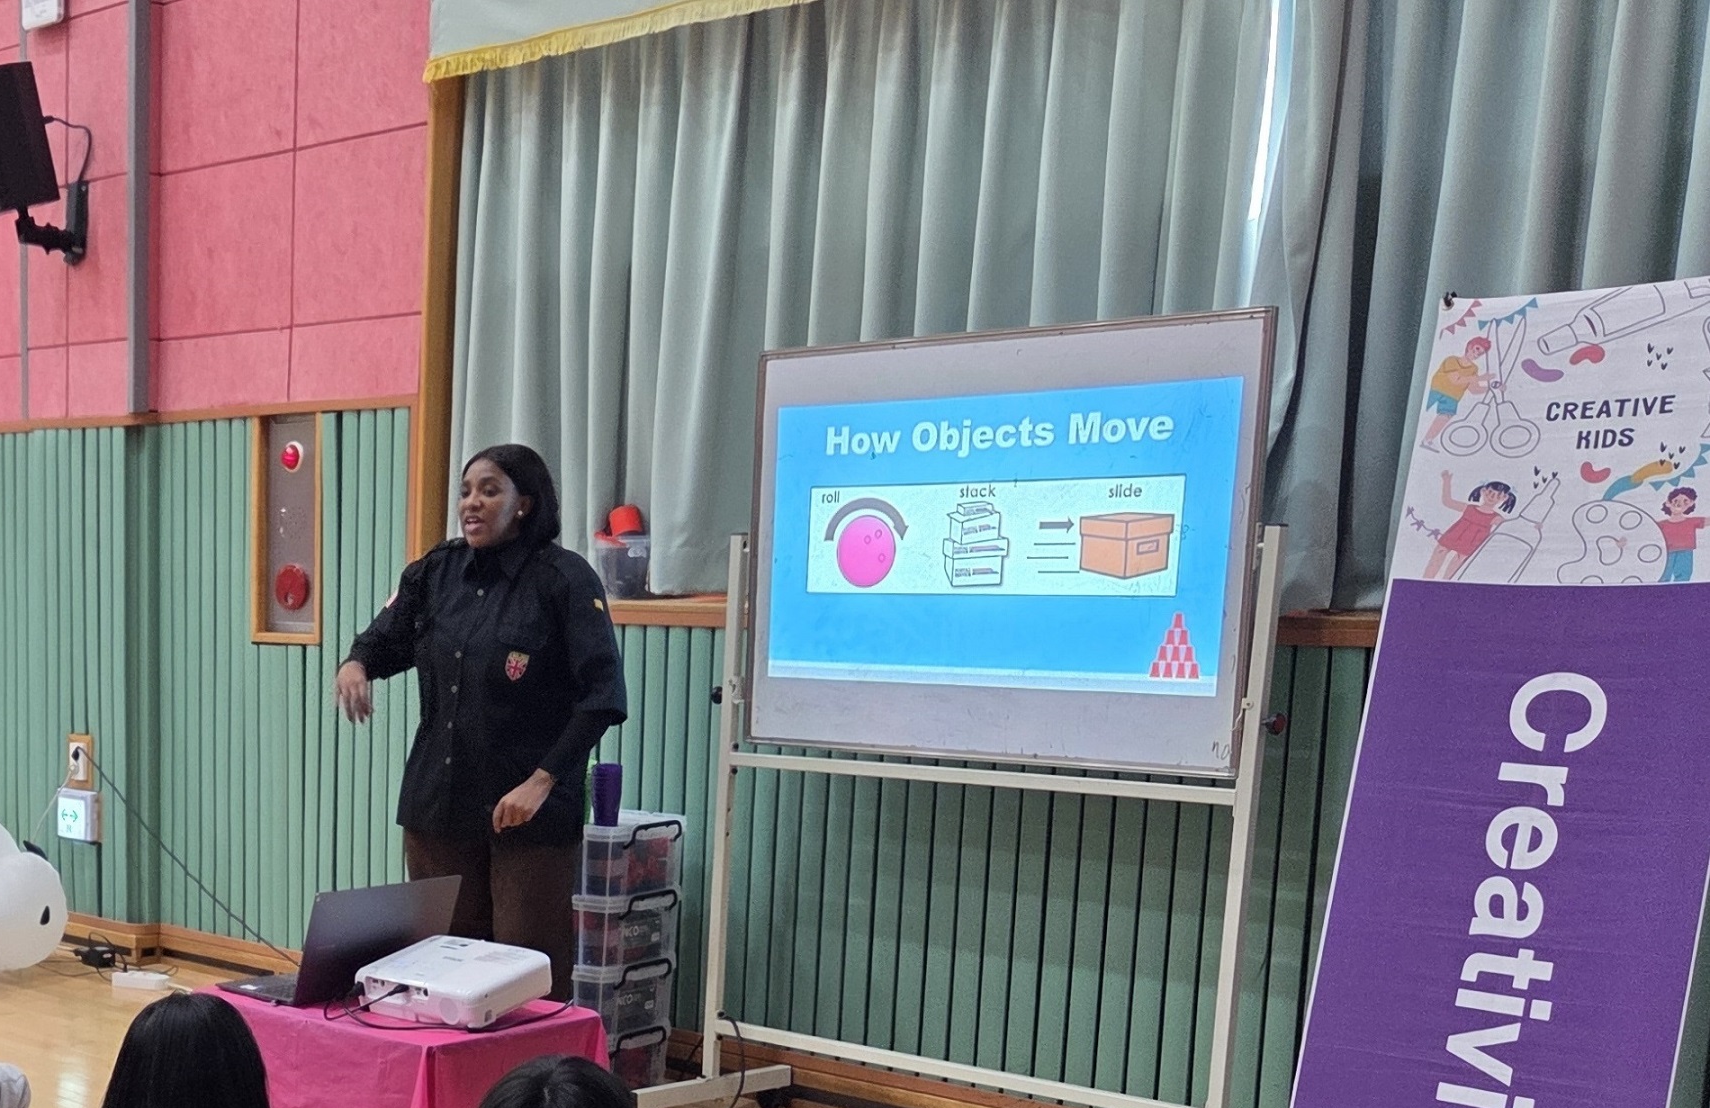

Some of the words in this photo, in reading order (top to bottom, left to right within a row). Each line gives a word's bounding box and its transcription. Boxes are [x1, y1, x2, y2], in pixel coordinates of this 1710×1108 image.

[1545, 395, 1676, 422] CREATIVE
[825, 424, 901, 456] How
[911, 417, 1055, 458] Objects
[1068, 411, 1174, 445] Move
[1576, 427, 1635, 450] KIDS
[820, 490, 840, 504] roll
[959, 483, 996, 498] stack
[1108, 483, 1143, 498] slide
